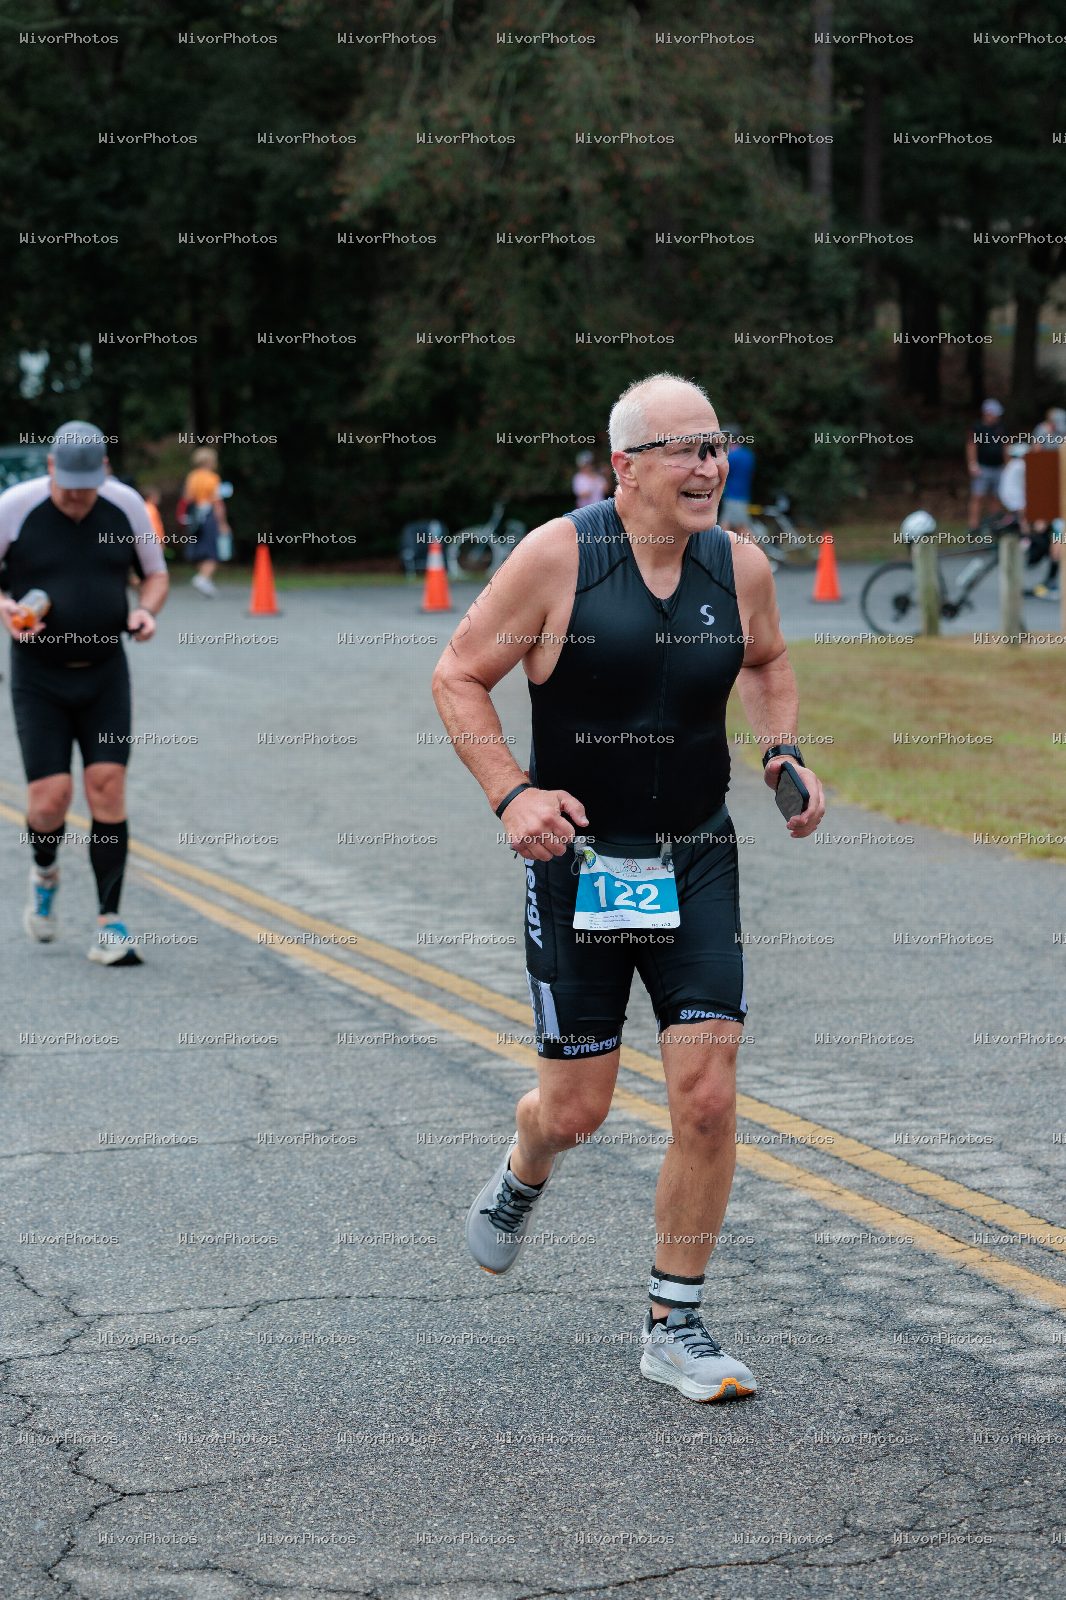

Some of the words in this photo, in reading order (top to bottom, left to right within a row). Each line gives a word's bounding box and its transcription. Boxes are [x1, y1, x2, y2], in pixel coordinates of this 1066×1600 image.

[525, 858, 543, 949] ergy
[593, 875, 661, 910] 122
[563, 1035, 618, 1056] synergy
